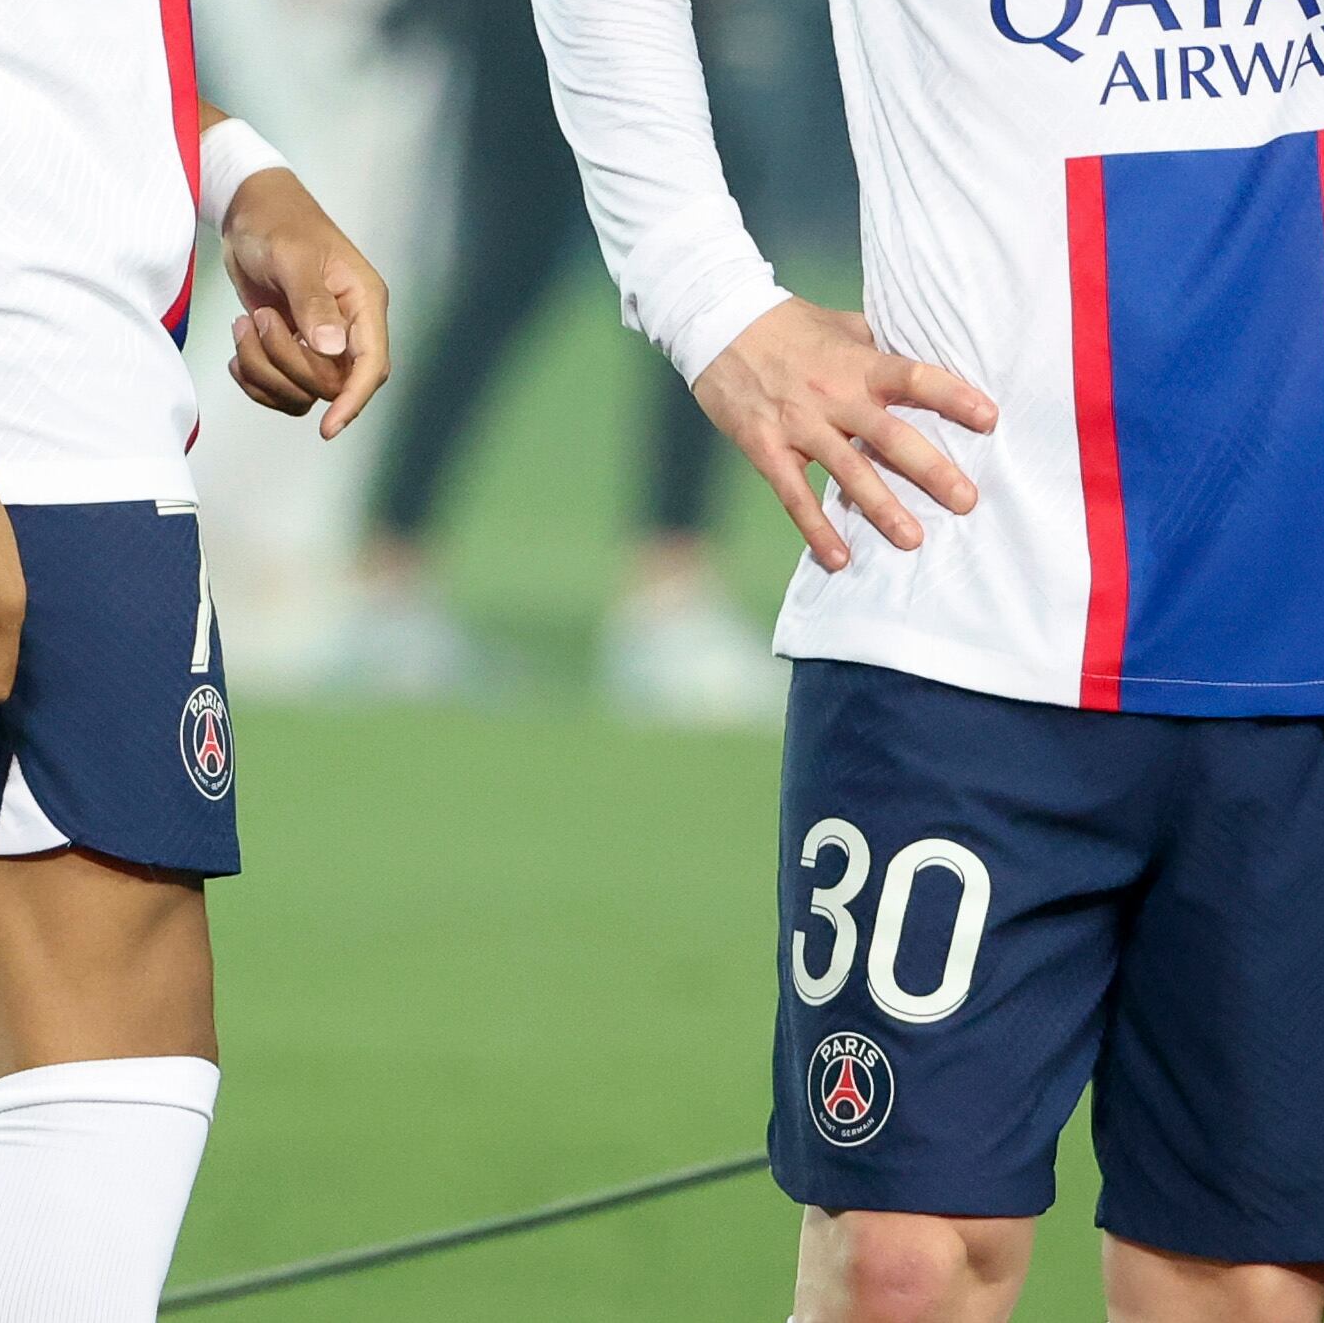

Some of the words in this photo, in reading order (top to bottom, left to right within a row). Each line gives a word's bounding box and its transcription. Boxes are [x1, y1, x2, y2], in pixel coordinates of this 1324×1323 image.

[189, 690, 224, 719] PARIS
[791, 817, 991, 1024] 30
[820, 1037, 879, 1067] PARIS
